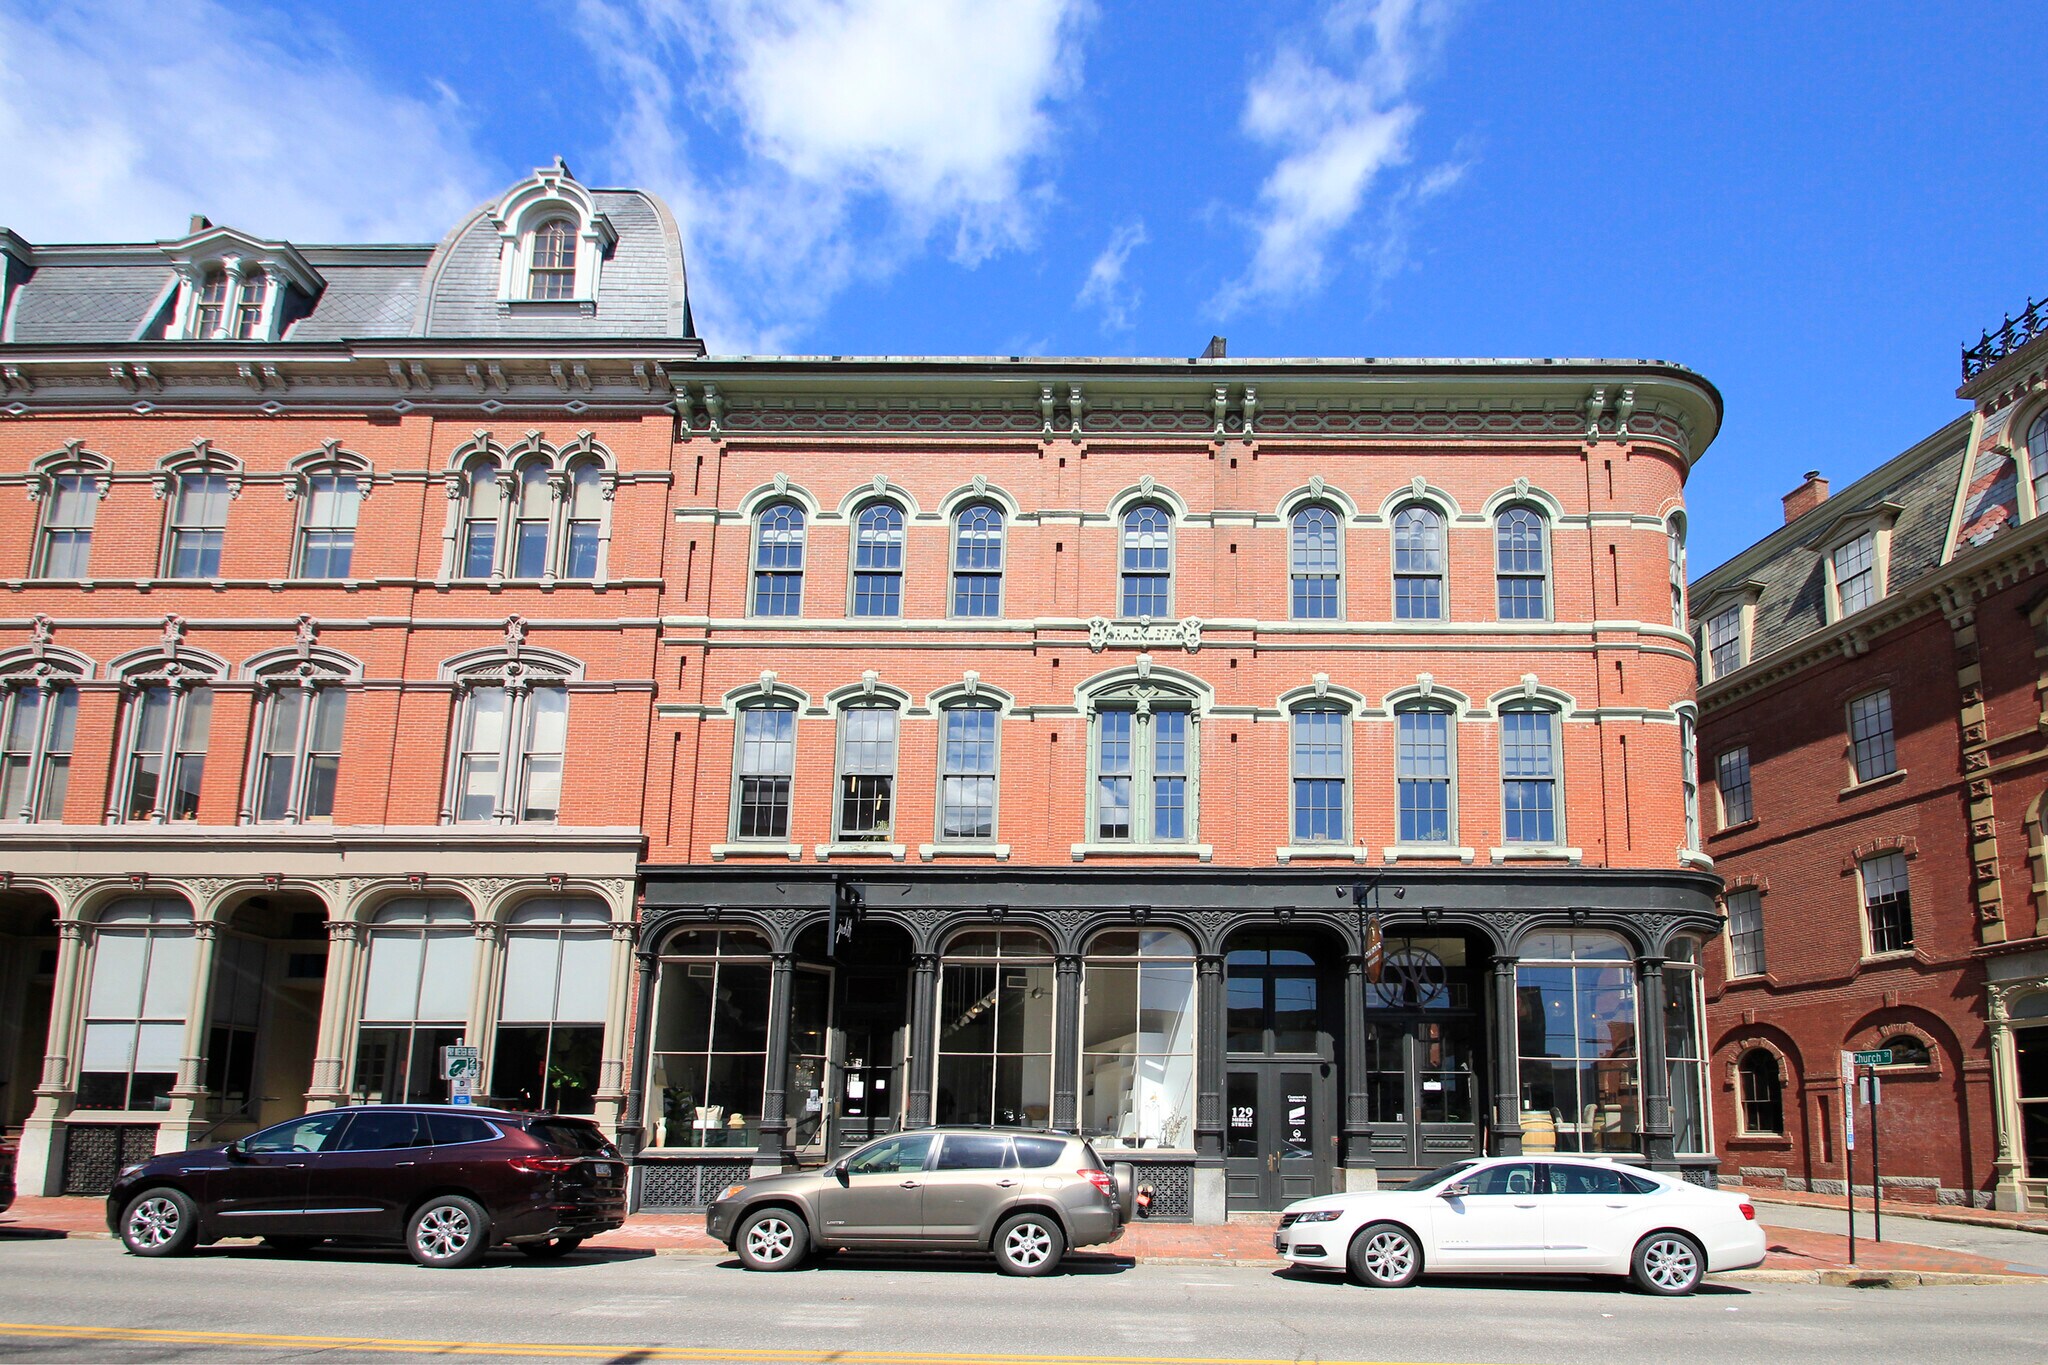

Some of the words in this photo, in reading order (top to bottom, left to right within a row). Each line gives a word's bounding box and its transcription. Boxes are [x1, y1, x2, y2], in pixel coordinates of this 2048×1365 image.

[1114, 627, 1176, 641] RACKLEFF
[1853, 1053, 1882, 1063] Church
[1231, 1107, 1254, 1118] 129
